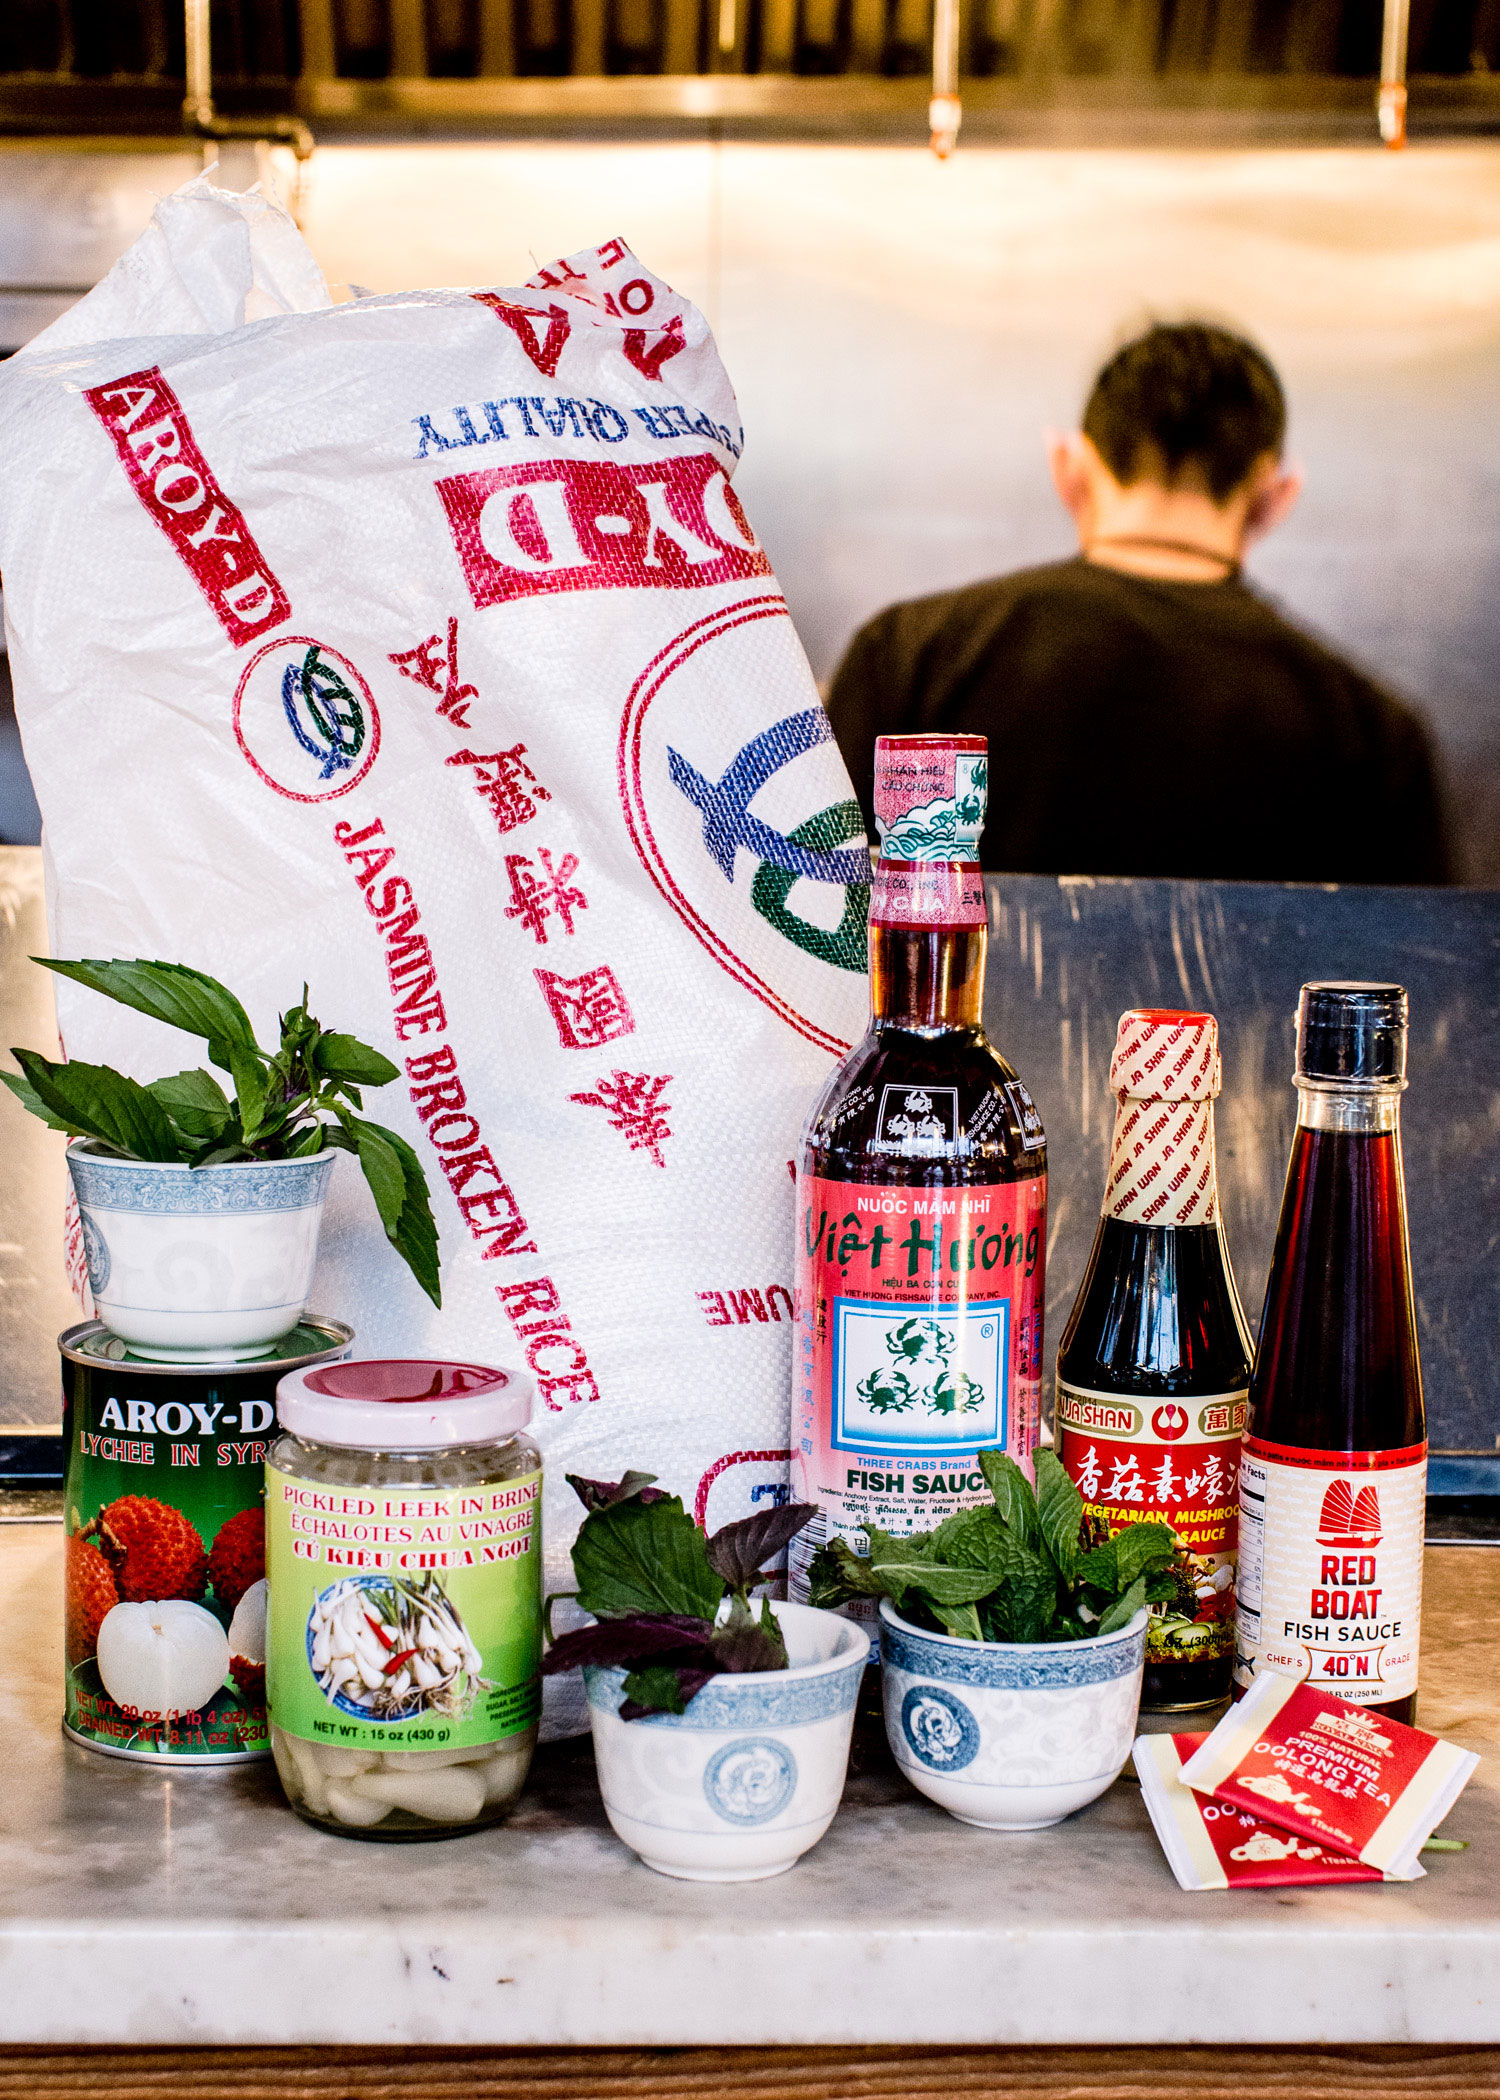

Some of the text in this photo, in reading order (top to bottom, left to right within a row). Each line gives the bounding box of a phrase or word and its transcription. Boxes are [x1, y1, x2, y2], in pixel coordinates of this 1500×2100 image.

[411, 395, 630, 460] QUALITY
[103, 386, 275, 628] AROY-D
[1120, 1017, 1136, 1035] WA
[1141, 1023, 1160, 1041] WA
[1130, 1025, 1186, 1086] JA SHAN WA
[1122, 1110, 1140, 1139] SHAN
[1162, 1074, 1175, 1091] JA
[1173, 1045, 1195, 1075] SHAN
[332, 816, 600, 1413] JASMINE BROKEN RICE
[1114, 1158, 1133, 1184] WAN
[1133, 1142, 1145, 1158] JA
[1144, 1113, 1169, 1144] SHAN
[1191, 1075, 1201, 1091] JA
[1113, 1114, 1195, 1216] SHAN WAN JA SHAN
[1141, 1191, 1170, 1222] SHAN
[1168, 1163, 1191, 1192] WAN
[1190, 1145, 1200, 1161] JA
[1176, 1191, 1200, 1224] SHAN
[805, 1206, 1040, 1278] Việt Hương
[844, 1289, 861, 1298] VIET
[862, 1291, 893, 1300] HUONG
[944, 1292, 987, 1301] COPANY,
[987, 1290, 1001, 1299] INC.
[906, 1280, 919, 1289] BA
[946, 1280, 961, 1289] CU
[100, 1397, 274, 1435] AROY-D
[1067, 1401, 1080, 1422] JA
[1083, 1405, 1132, 1430] SHAN
[80, 1431, 274, 1467] LYCHEE IN SYR
[857, 1457, 893, 1469] THREE
[897, 1460, 937, 1471] CRABS
[940, 1459, 972, 1471] Brand
[1267, 1452, 1284, 1462] patis
[847, 1469, 904, 1494] FISH
[1247, 1465, 1266, 1481] Facts
[284, 1481, 539, 1518] PICKLED LEEK IN BRINE
[844, 1491, 868, 1502] Anchovy
[869, 1494, 890, 1504] Extract,
[892, 1496, 905, 1505] Salt,
[907, 1497, 927, 1505] Water,
[291, 1508, 534, 1543] ÉCHALOTES AU VINAGRE
[1181, 1527, 1226, 1544] SAUCE
[327, 1546, 391, 1570] KIỆU
[400, 1551, 475, 1569] CHUA
[480, 1535, 531, 1564] NGỌT
[1321, 1555, 1376, 1586] RED
[1311, 1589, 1382, 1620] BOAT
[1284, 1622, 1329, 1641] FISH
[1338, 1621, 1401, 1642] SAUCE
[1267, 1653, 1303, 1668] CHEF'S
[1385, 1652, 1410, 1667] GRADE
[75, 1687, 94, 1708] NET
[95, 1697, 117, 1718] WT.
[121, 1704, 138, 1720] 20
[142, 1710, 161, 1723] oz
[186, 1710, 202, 1724] lb
[206, 1709, 216, 1724] 4
[221, 1708, 248, 1725] oz)
[1344, 1690, 1353, 1698] OZ
[1355, 1690, 1369, 1698] (250
[78, 1709, 133, 1740] DRAINED
[138, 1727, 166, 1743] WT.
[170, 1730, 201, 1745] 8.11
[208, 1733, 229, 1744] oz
[313, 1720, 450, 1742] NET WT 15 oz (430 g)
[1285, 1737, 1380, 1781] PREMIUM
[1299, 1731, 1382, 1770] 100% NATURAL
[1254, 1742, 1390, 1807] OOLONG TEA
